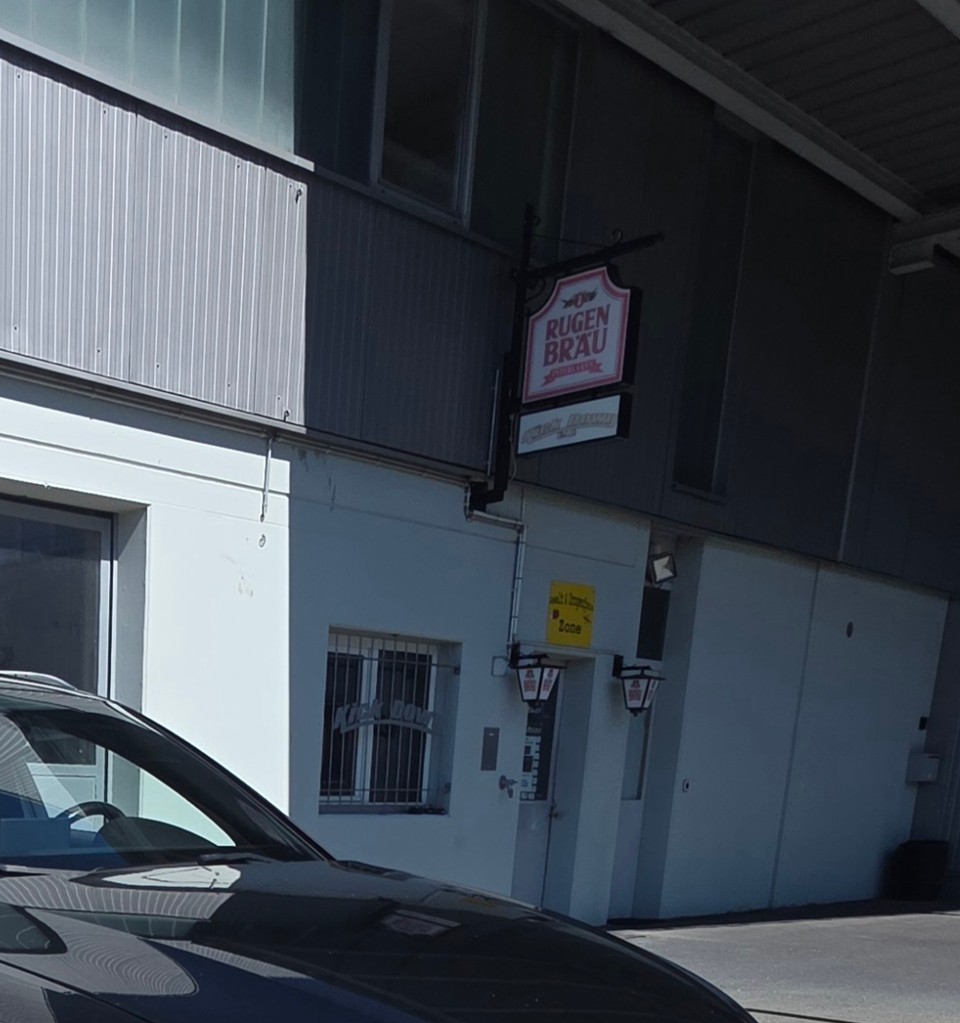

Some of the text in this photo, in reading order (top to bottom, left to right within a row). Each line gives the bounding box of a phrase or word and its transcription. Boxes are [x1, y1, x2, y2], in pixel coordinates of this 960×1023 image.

[545, 304, 611, 341] RUGEN
[543, 327, 608, 367] BRÄU
[558, 619, 582, 635] Zone
[390, 700, 439, 728] DOW
